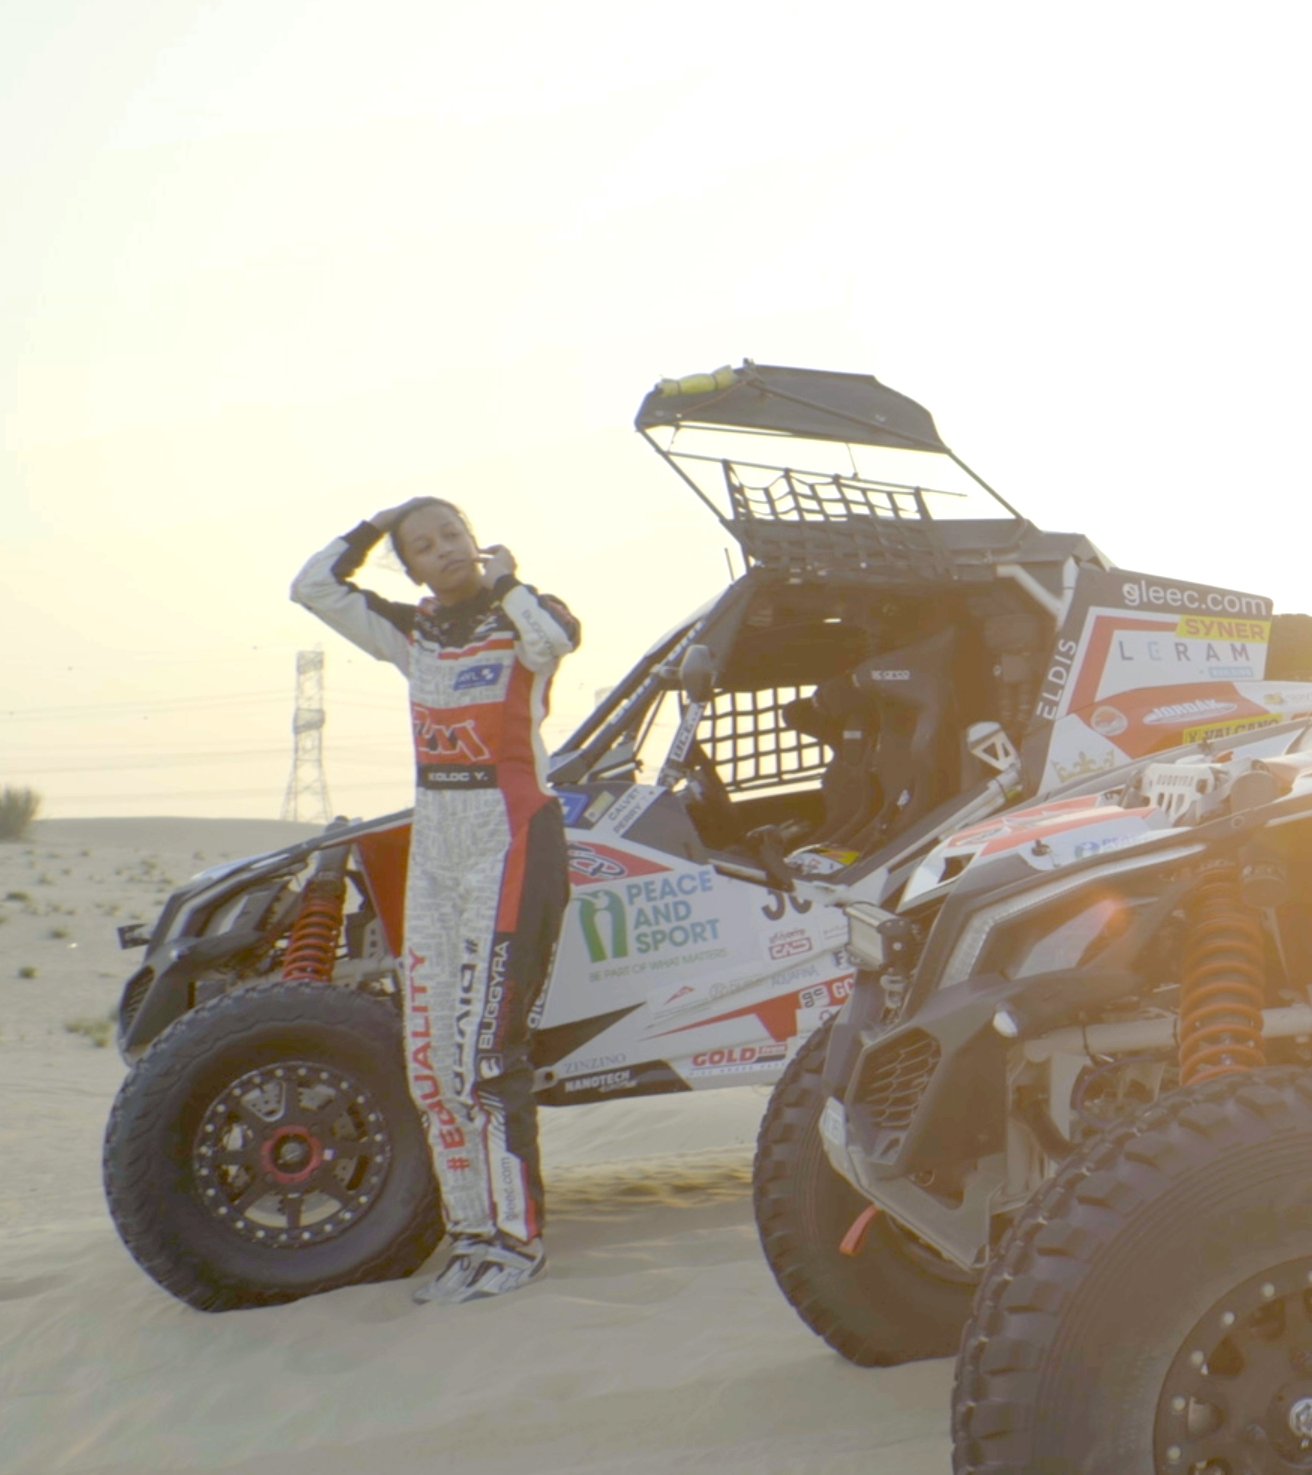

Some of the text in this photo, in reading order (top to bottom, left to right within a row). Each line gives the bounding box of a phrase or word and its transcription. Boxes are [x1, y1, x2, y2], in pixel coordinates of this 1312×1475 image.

[1122, 581, 1267, 616] gleec.com
[1185, 619, 1265, 641] SYNER
[1119, 641, 1250, 662] LERAM
[429, 772, 469, 783] KOLOC
[627, 870, 713, 905] PEACE
[634, 900, 692, 930] AND
[636, 919, 720, 954] SPORT
[479, 941, 511, 1049] BUGGYRA
[565, 1053, 626, 1074] ZINZINO
[693, 1047, 757, 1067] GOLD
